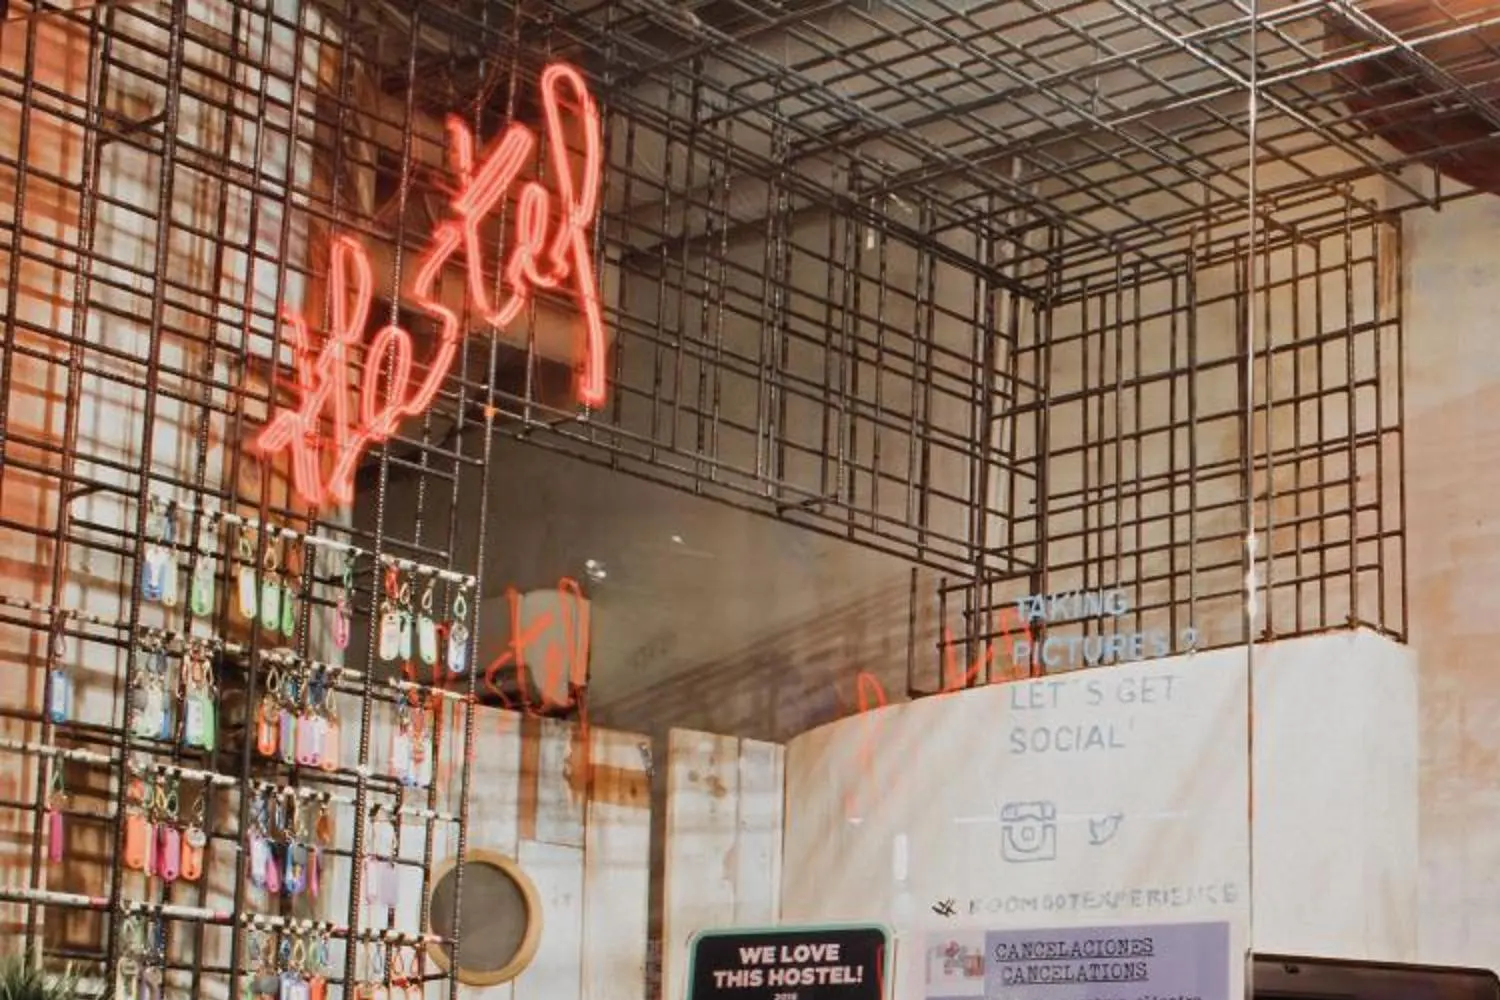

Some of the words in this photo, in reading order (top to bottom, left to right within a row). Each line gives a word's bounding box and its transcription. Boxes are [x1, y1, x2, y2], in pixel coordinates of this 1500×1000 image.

[258, 62, 606, 506] Hostel
[1018, 589, 1129, 623] TAKING
[1116, 674, 1177, 705] GET
[739, 947, 775, 964] WE
[781, 943, 841, 963] LOVE
[994, 937, 1155, 960] CANCELACIONES
[713, 969, 763, 988] THIS
[768, 965, 864, 986] HOSTEL!
[1001, 961, 1150, 984] CANCELATIONS
